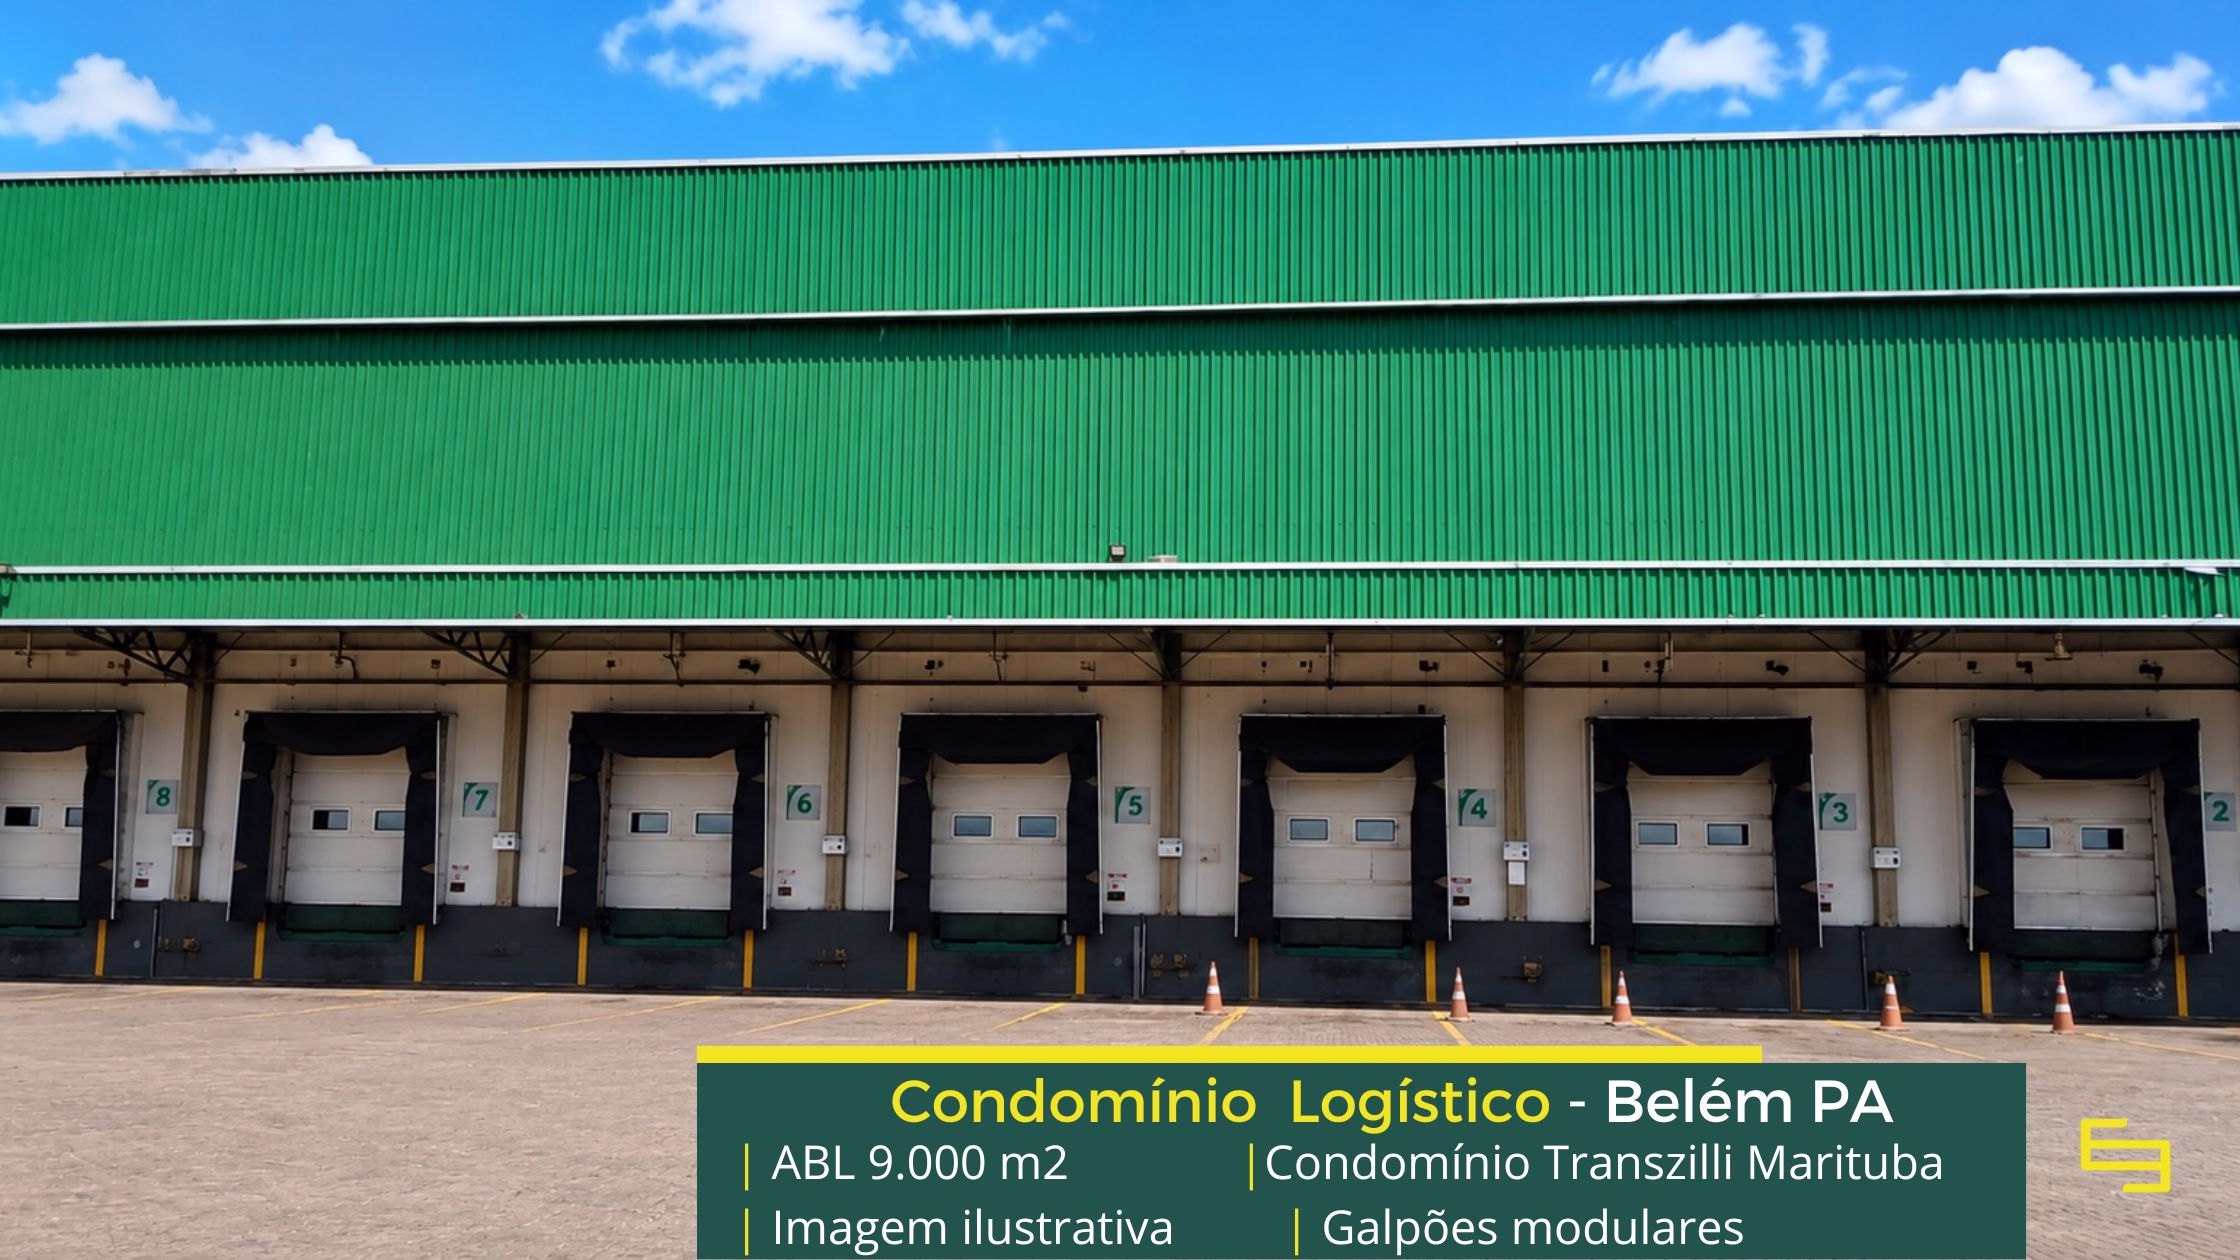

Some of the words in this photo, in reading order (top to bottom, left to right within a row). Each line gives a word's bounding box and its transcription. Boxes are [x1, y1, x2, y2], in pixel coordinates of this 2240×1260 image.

[156, 788, 171, 810] 8
[475, 790, 488, 812] 7
[796, 793, 812, 813] 6
[1128, 796, 1143, 816] 5
[1470, 797, 1488, 819] 4
[1833, 802, 1848, 823] 3
[2211, 800, 2229, 821] 2
